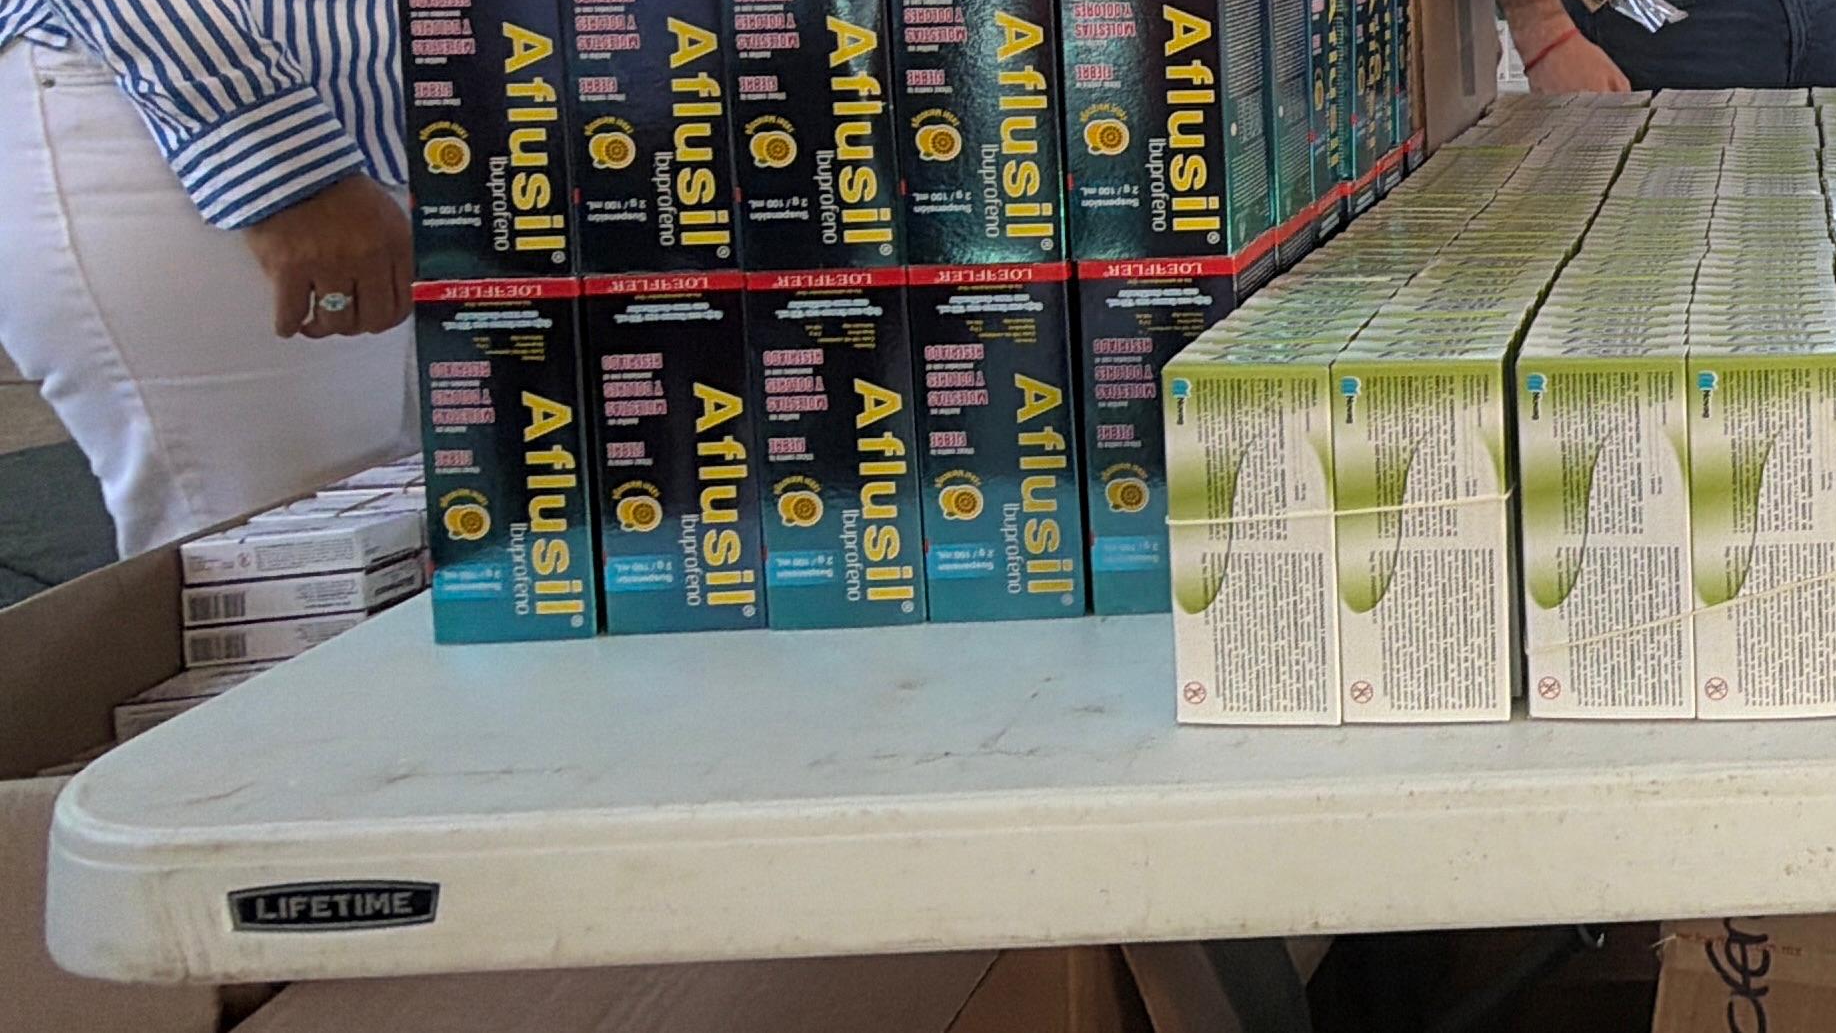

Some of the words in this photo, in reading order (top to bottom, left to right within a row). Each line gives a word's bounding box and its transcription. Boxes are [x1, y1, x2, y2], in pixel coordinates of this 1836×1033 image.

[503, 22, 566, 250] Aflusil
[667, 16, 730, 245] Aflusil
[826, 15, 892, 243] Aflusil
[995, 10, 1053, 237] Aflusil
[1162, 4, 1220, 231] Aflusil
[489, 156, 509, 251] Ibuprofeno
[653, 151, 674, 247] Ibuprofeno
[815, 149, 837, 244] Ibuprofeno
[980, 144, 1000, 237] Ibuprofeno
[1148, 138, 1167, 232] Ibuprofeno
[522, 391, 584, 616] Aflusil
[693, 382, 754, 605] Aflusil
[853, 378, 914, 602] Aflusil
[1014, 373, 1073, 595] Aflusil
[510, 523, 530, 616] Ibuprofeno
[680, 514, 701, 607] Ibuprofeno
[841, 509, 861, 602] Ibuprofeno
[1002, 502, 1021, 595] Ibuprofeno
[255, 891, 414, 920] LIFETIME
